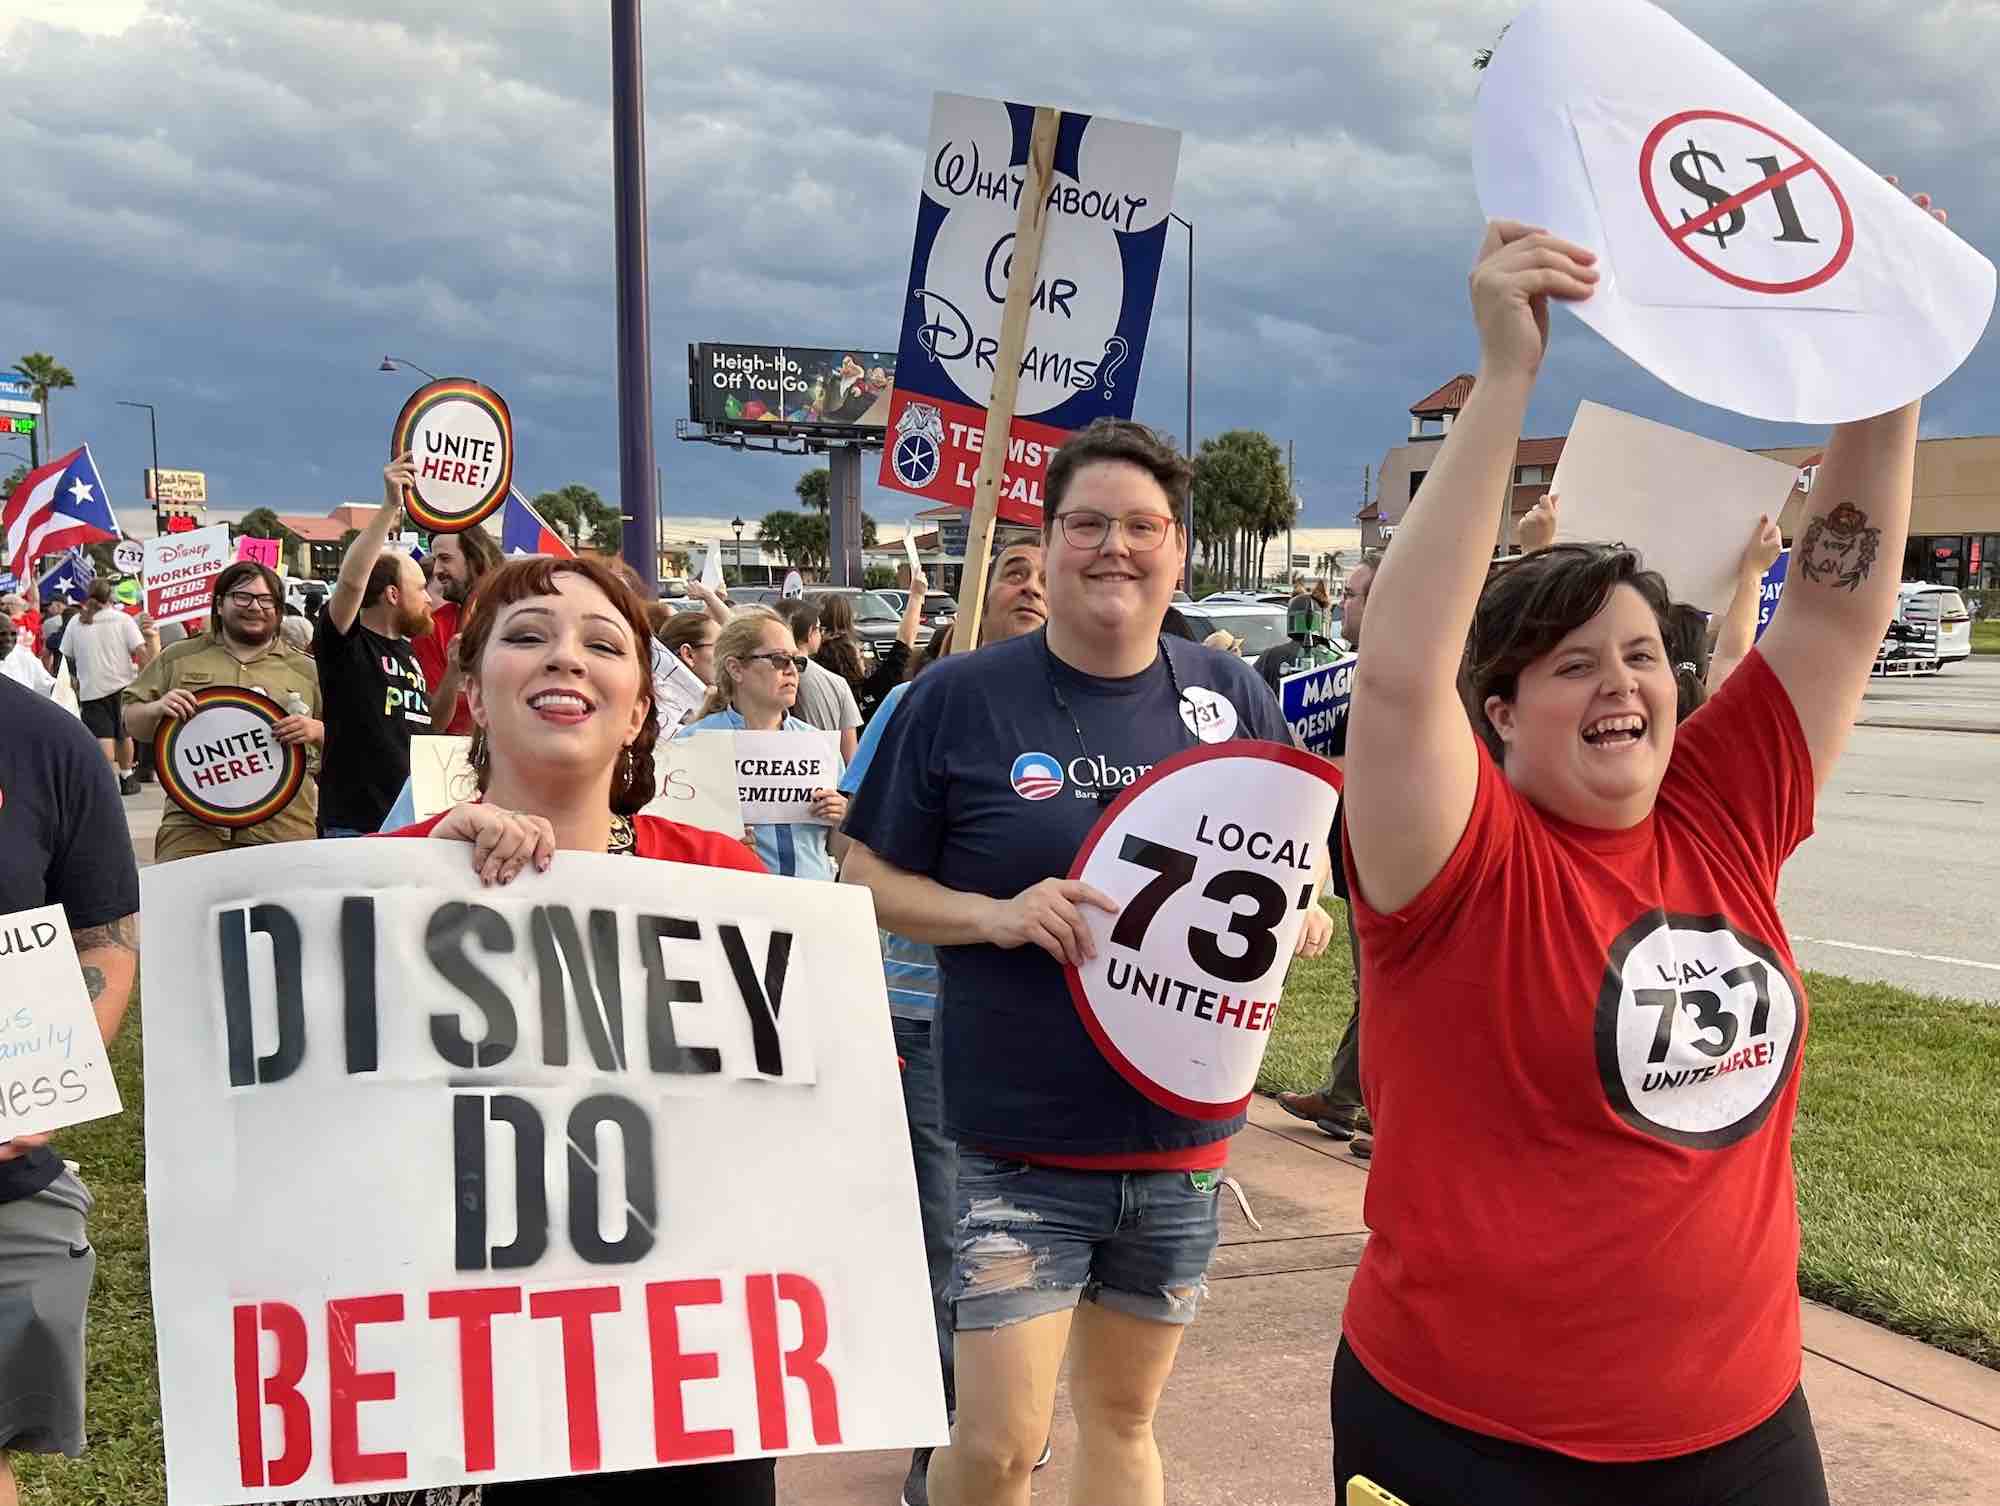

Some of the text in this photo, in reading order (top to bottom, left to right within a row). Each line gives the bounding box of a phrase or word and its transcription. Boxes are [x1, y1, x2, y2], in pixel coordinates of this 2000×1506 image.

[1046, 183, 1147, 231] ABOUT
[1669, 139, 1819, 249] $1
[712, 352, 803, 375] Heigh-Ho,
[914, 289, 1128, 400] DRAMS?
[713, 372, 808, 392] Off You Go
[425, 430, 495, 463] UNITE
[421, 456, 489, 488] HERE!
[118, 549, 144, 563] 737
[147, 559, 223, 586] WORKERS
[161, 578, 206, 600] NEEDS
[170, 592, 213, 613] RAISE
[184, 728, 268, 766] UNITE
[193, 751, 275, 789] HERE!
[1196, 815, 1311, 870] LOCAL
[1109, 833, 1314, 983] 73
[219, 895, 792, 1088] DISNEY
[1632, 961, 1771, 1064] 737
[452, 1093, 659, 1271] DO
[232, 1273, 843, 1488] BETTER
